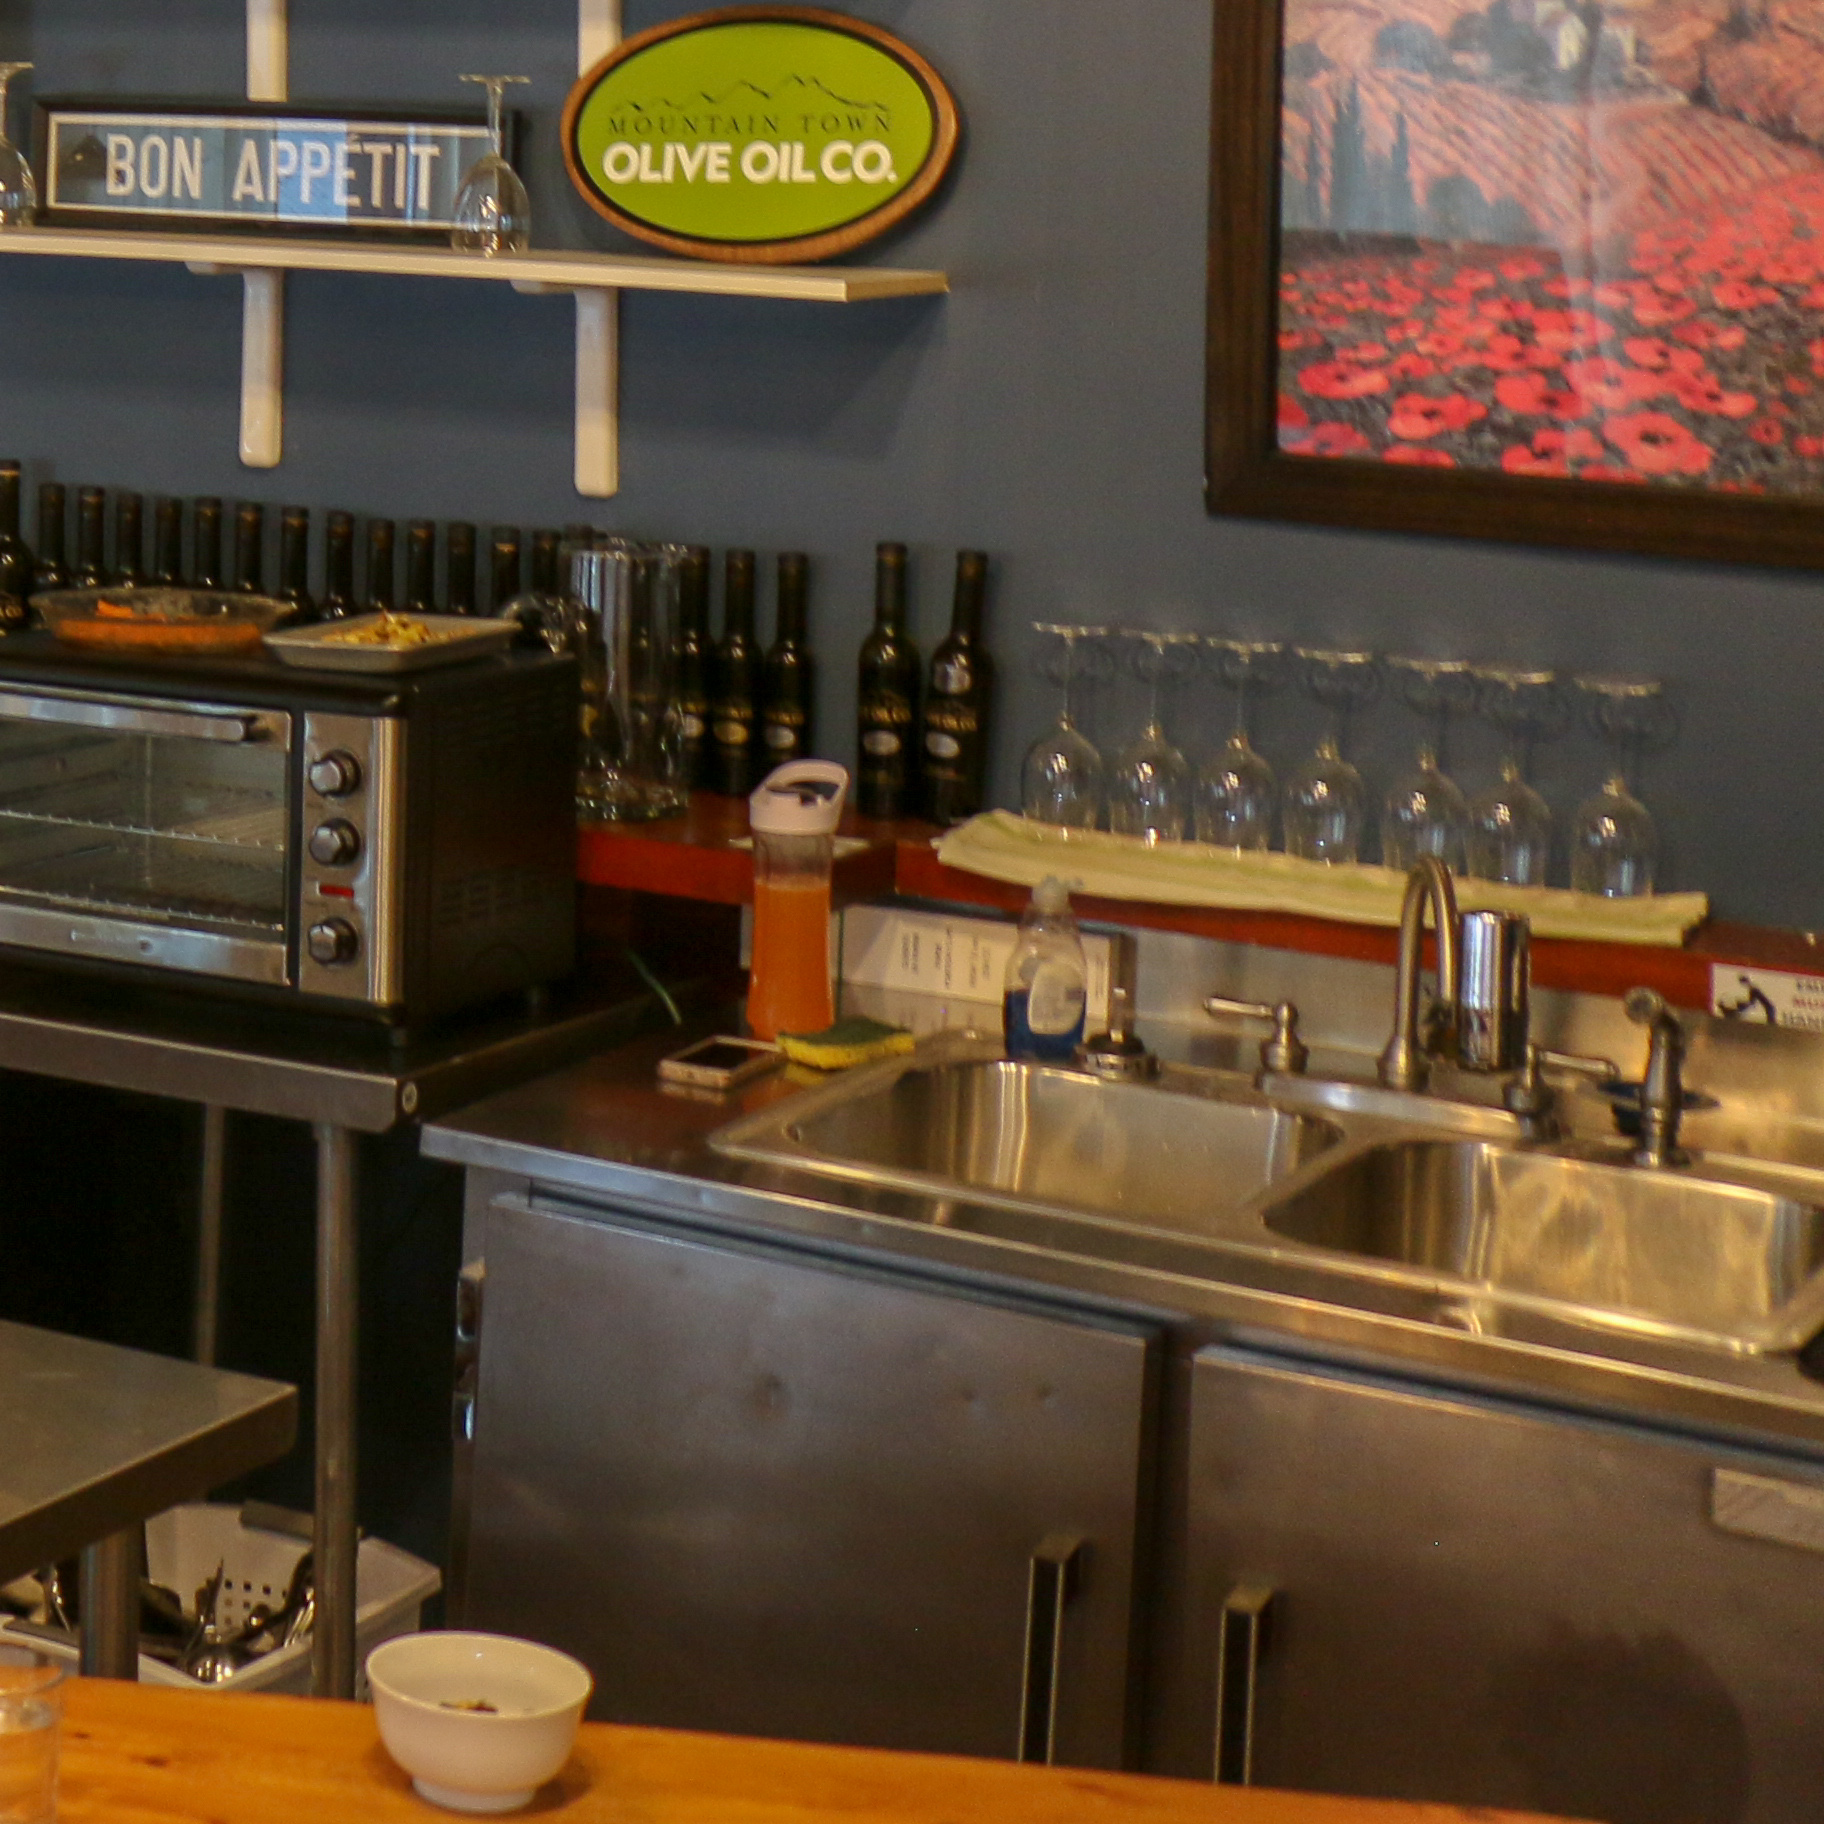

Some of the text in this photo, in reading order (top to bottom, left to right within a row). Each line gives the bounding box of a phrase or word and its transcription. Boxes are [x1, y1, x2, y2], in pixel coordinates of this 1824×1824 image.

[608, 110, 892, 135] MOUNTAIN TOWN
[105, 132, 203, 200] BON
[602, 139, 899, 185] OLIVE OIL CO.
